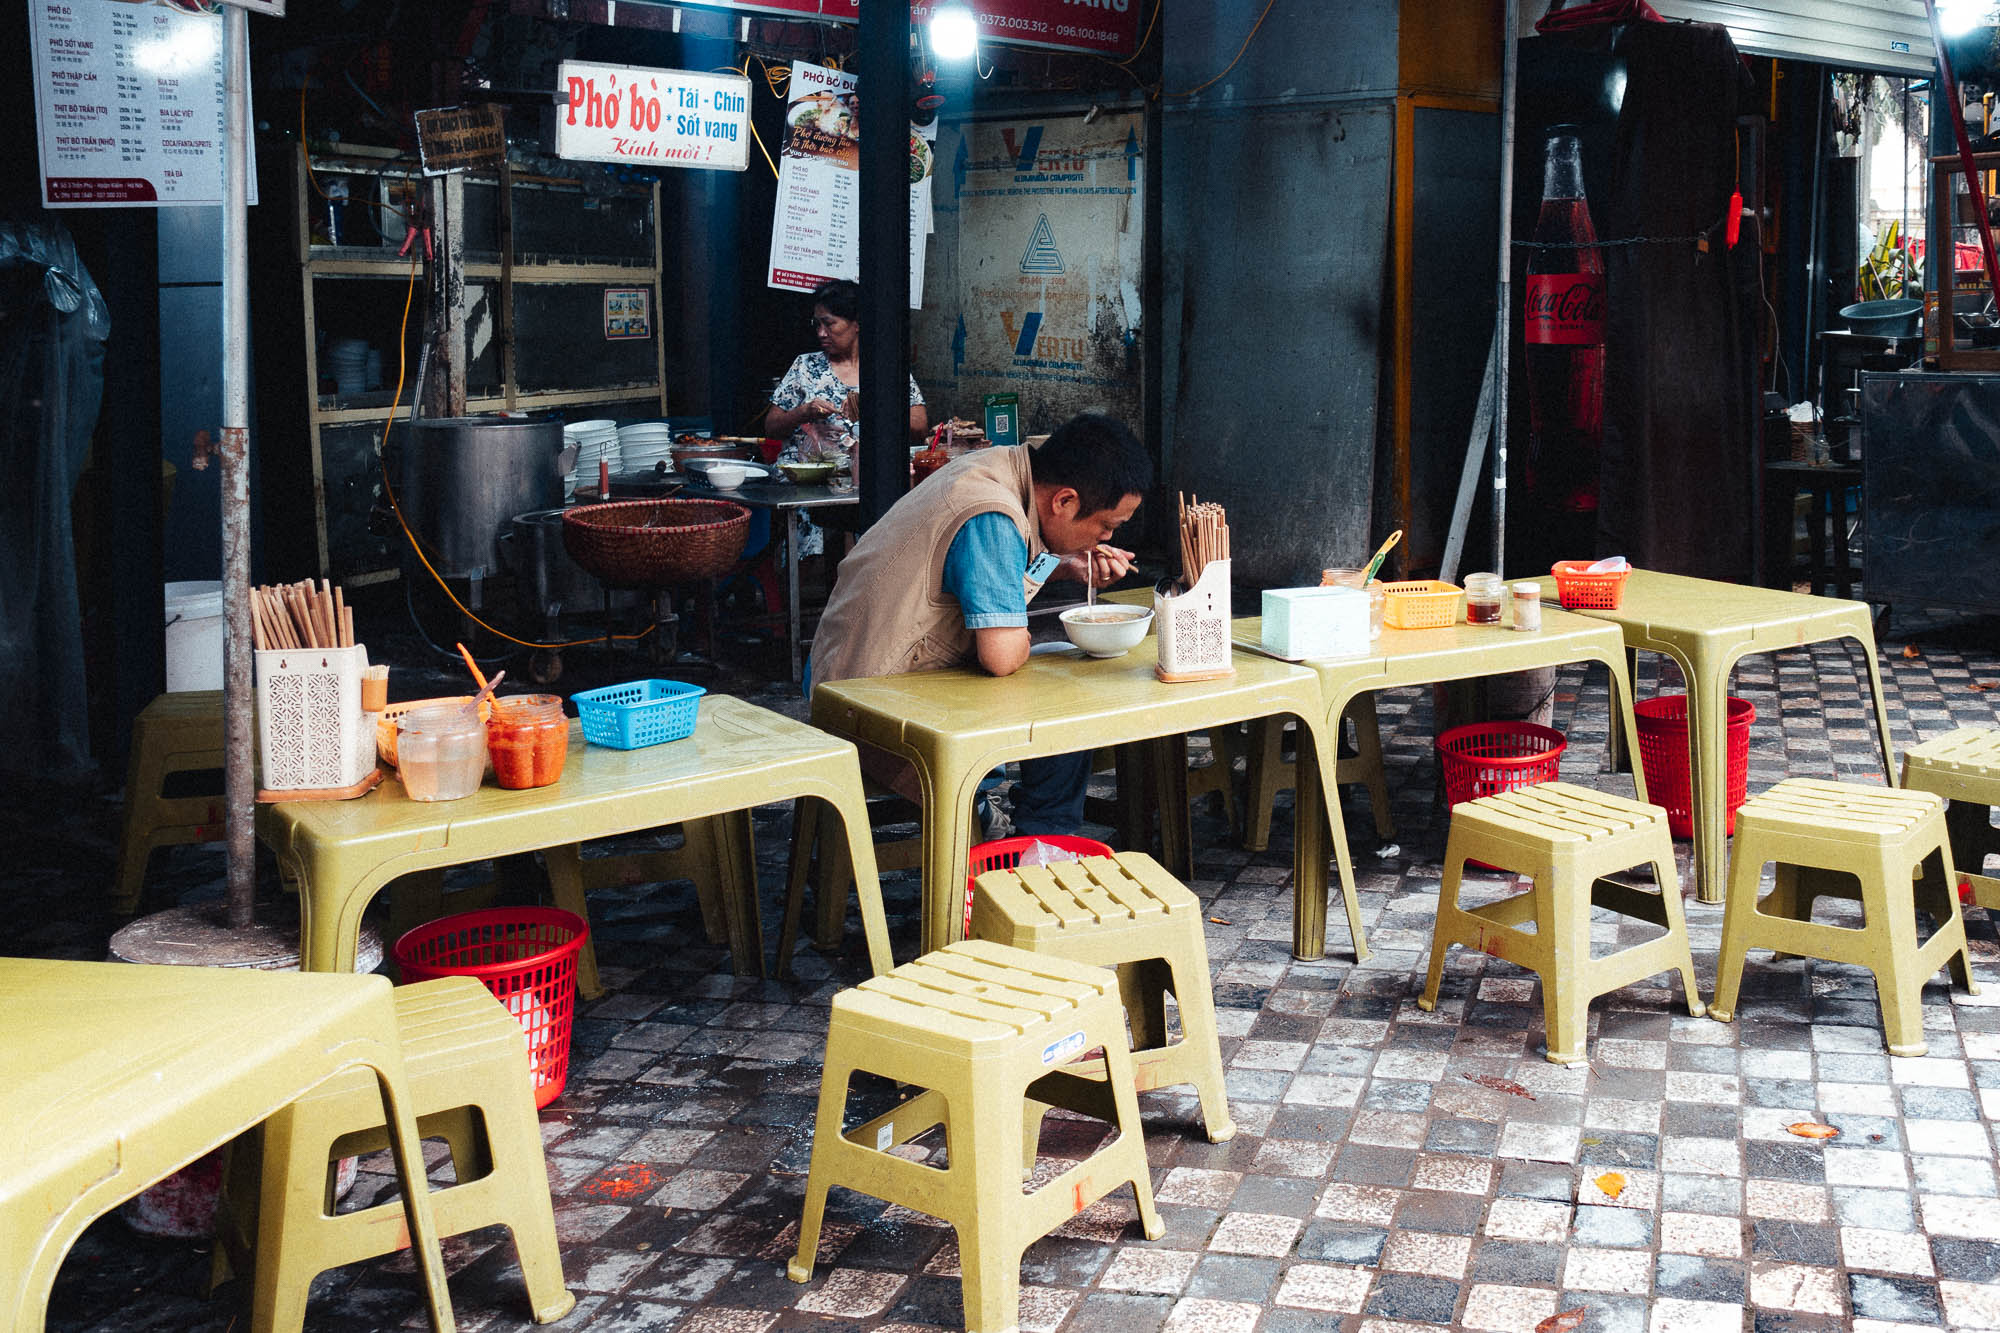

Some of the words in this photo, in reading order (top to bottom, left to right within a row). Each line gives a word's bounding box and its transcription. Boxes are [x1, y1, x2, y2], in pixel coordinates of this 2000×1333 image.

[980, 13, 1048, 33] 0373.003.312
[1056, 25, 1119, 42] 096.100.1848
[803, 70, 824, 84] PHỞ
[567, 74, 622, 129] Phở
[630, 78, 661, 132] bò
[678, 87, 699, 109] Tái
[677, 112, 700, 136] Sốt
[704, 121, 738, 142] vang
[611, 137, 658, 157] Kính
[665, 144, 701, 160] mời
[1050, 173, 1084, 181] COMPOSITE
